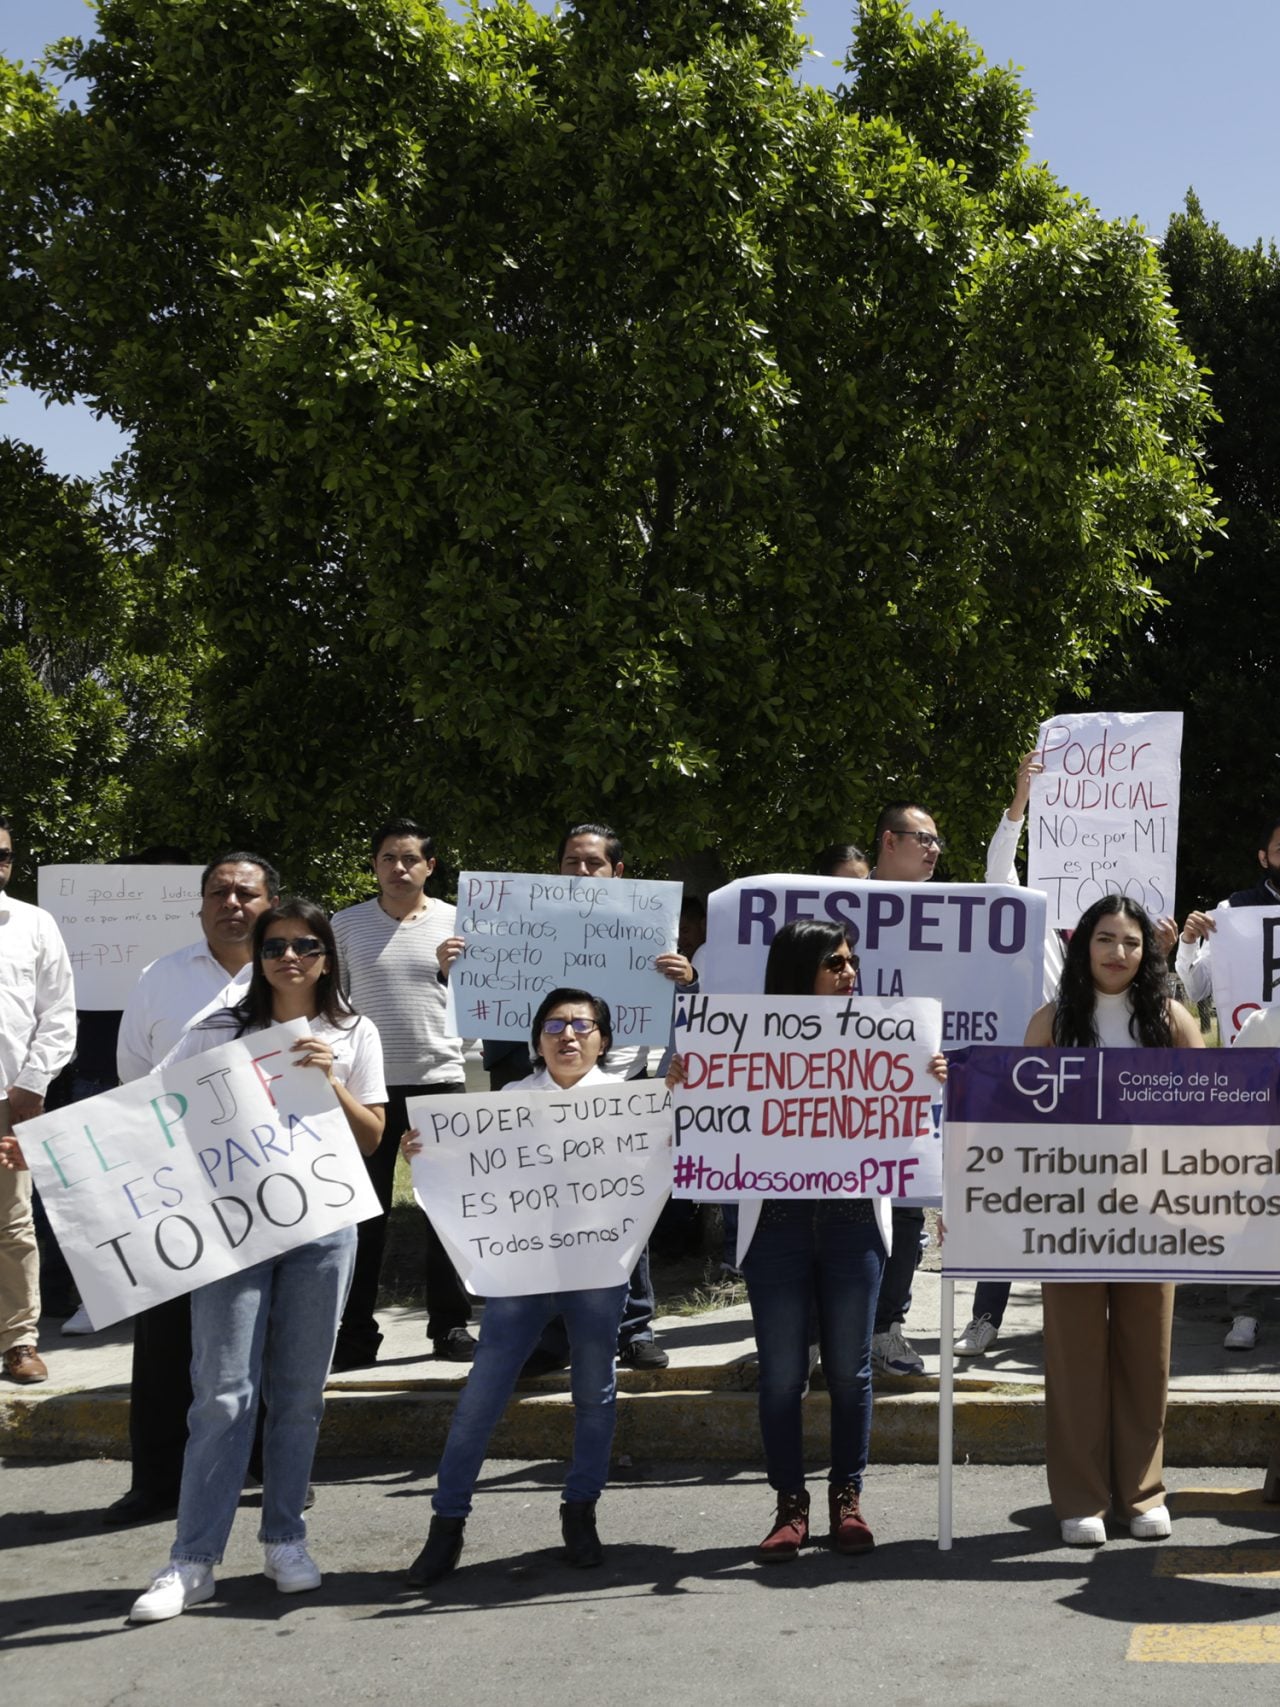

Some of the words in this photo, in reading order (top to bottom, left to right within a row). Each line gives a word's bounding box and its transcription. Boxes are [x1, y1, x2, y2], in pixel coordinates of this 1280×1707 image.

[1041, 725, 1152, 778] Poder
[1045, 777, 1169, 811] JUDICIAL
[1039, 815, 1078, 849] NO
[1081, 832, 1100, 847] es
[1103, 831, 1127, 857] por
[1134, 816, 1168, 854] MI
[1063, 860, 1082, 873] es
[1090, 859, 1118, 880] por
[60, 878, 74, 896] El
[88, 878, 144, 906] poder
[467, 878, 515, 911] PJF
[530, 879, 610, 919] protege
[628, 885, 663, 912] tus
[62, 915, 77, 923] no
[101, 915, 118, 924] por
[461, 911, 557, 942] derechos,
[583, 918, 666, 949] pedimos
[737, 888, 1027, 954] RESPETO
[70, 944, 140, 970] #PJF
[461, 942, 543, 977] respeto
[563, 950, 607, 977] para
[460, 969, 557, 992] nuestros
[876, 968, 904, 998] LA
[763, 1012, 822, 1041] nos
[836, 998, 916, 1041] toca
[682, 1048, 914, 1093] DEFENDERNOS
[1118, 1071, 1183, 1088] Consejo
[1188, 1071, 1209, 1086] de
[1213, 1072, 1228, 1086] la
[1119, 1088, 1205, 1102] Judicatura
[1210, 1088, 1270, 1103] Federal
[41, 1125, 130, 1189] EL
[150, 1051, 283, 1148] PJF
[431, 1107, 534, 1143] PODER
[549, 1091, 672, 1123] JUDICIA
[674, 1104, 751, 1147] para
[122, 1166, 183, 1220] ES
[198, 1113, 322, 1188] PARA
[469, 1148, 507, 1177] NO
[518, 1143, 553, 1169] ES
[563, 1137, 605, 1162] POR
[617, 1132, 649, 1154] MI
[1016, 1146, 1147, 1175] Tribunal
[673, 1153, 919, 1198] #todossomosPJF
[462, 1192, 498, 1218] ES
[509, 1184, 559, 1213] POR
[567, 1175, 645, 1204] TODOS
[965, 1187, 1085, 1214] Federal
[1098, 1188, 1138, 1214] de
[95, 1153, 356, 1287] TODOS
[1023, 1227, 1225, 1256] Individuales
